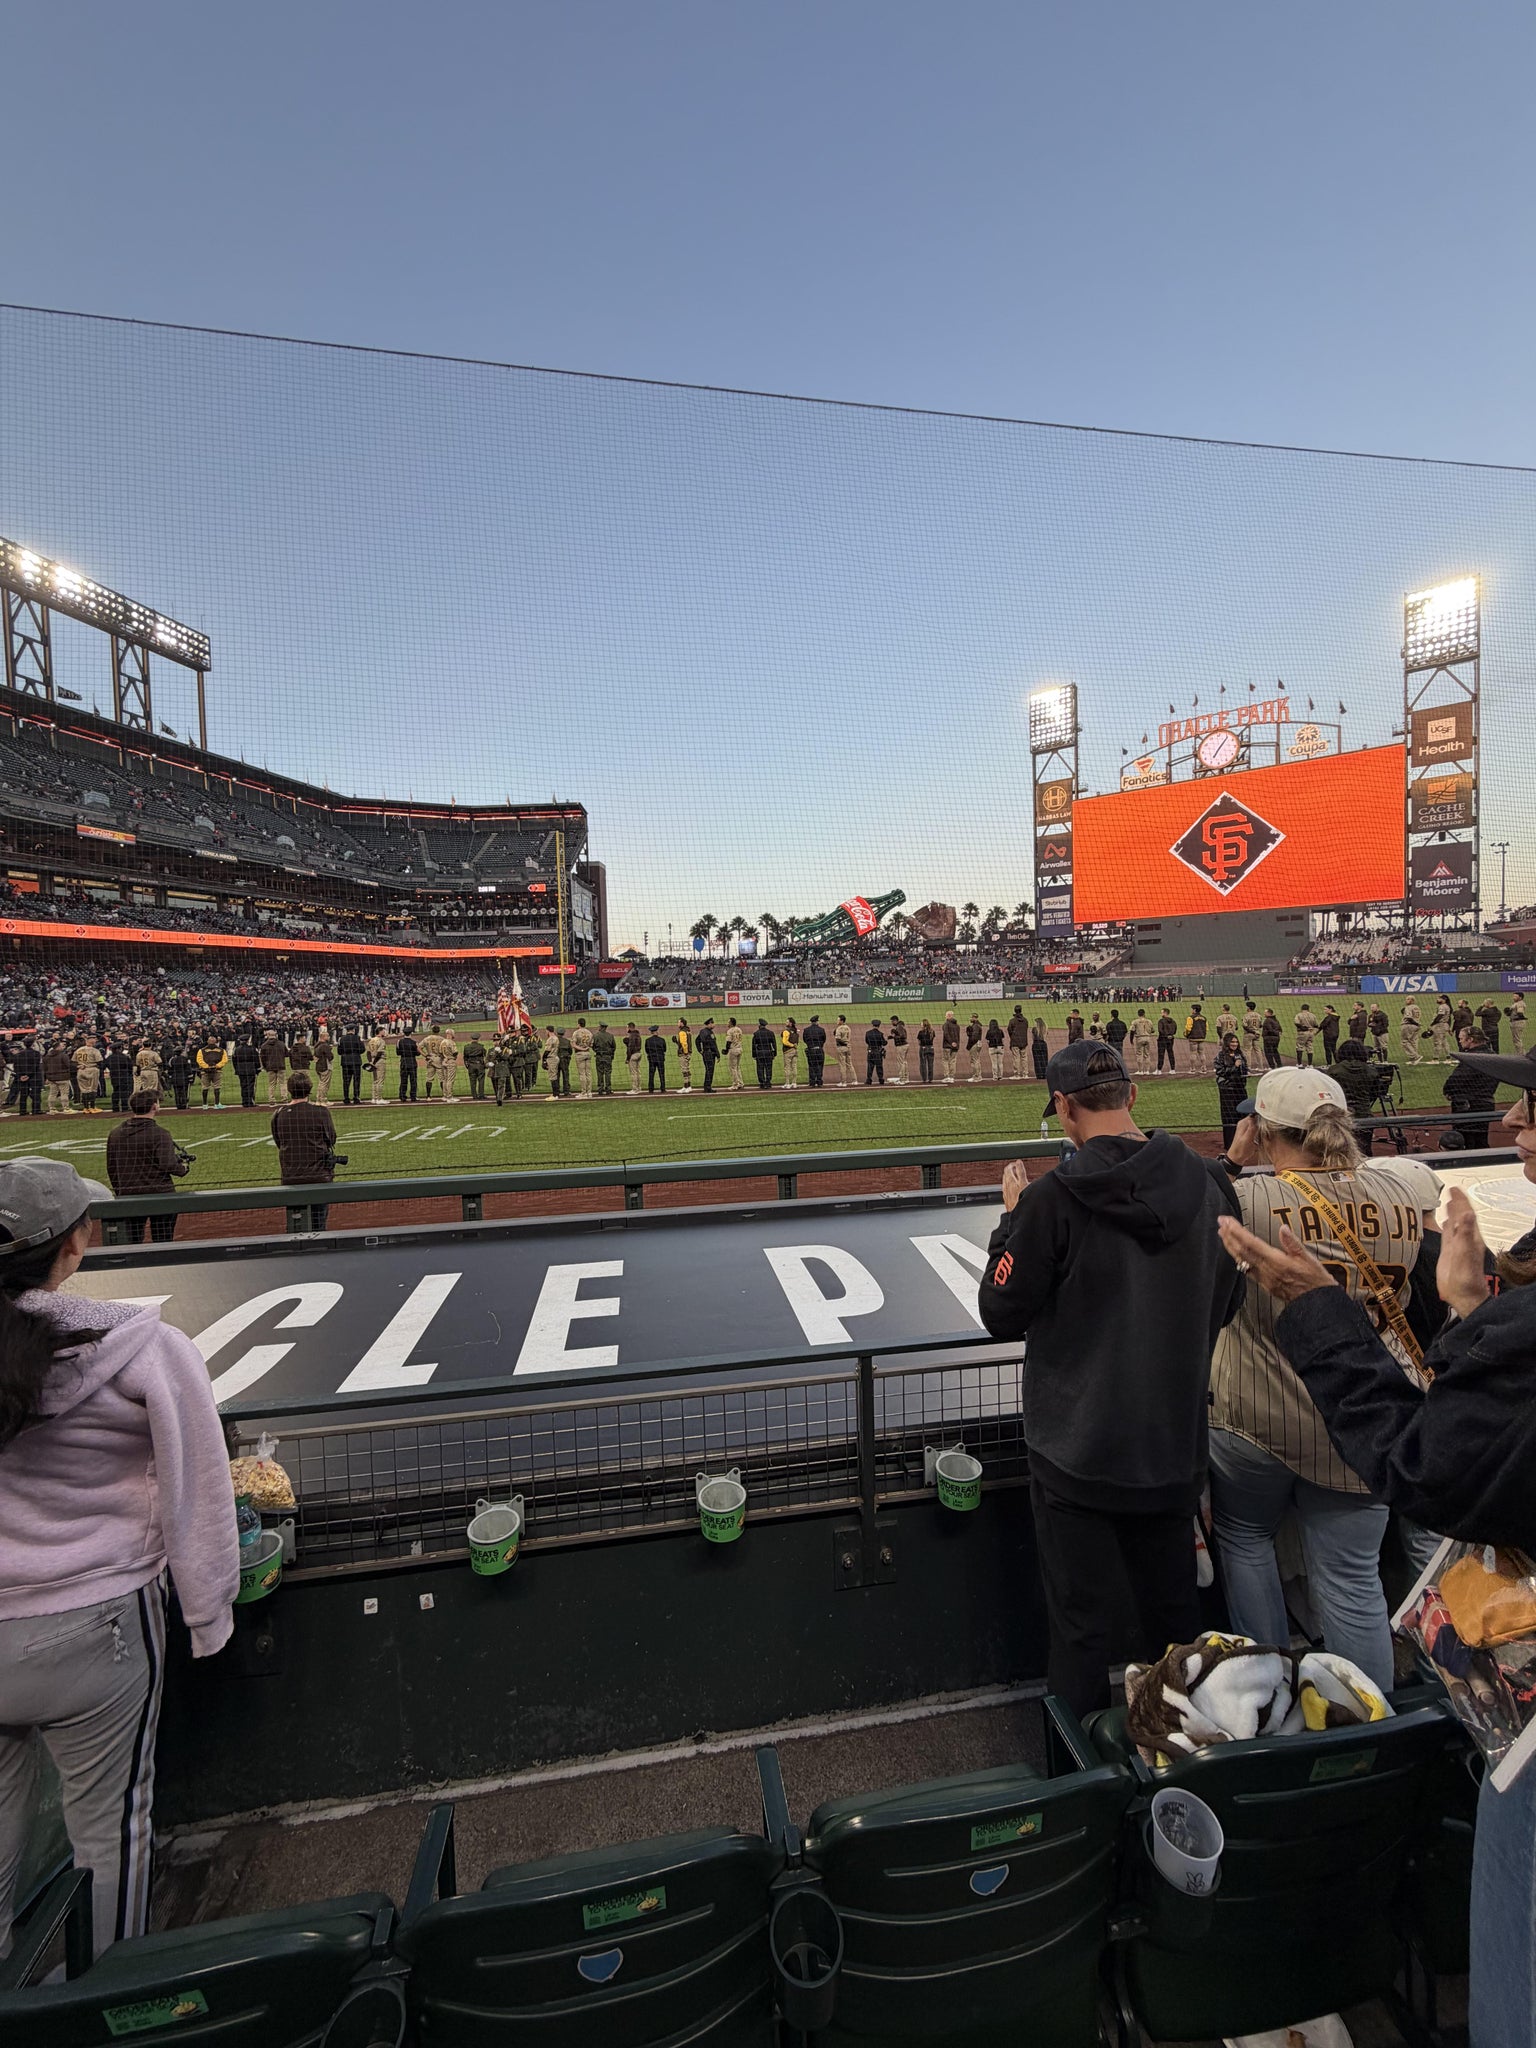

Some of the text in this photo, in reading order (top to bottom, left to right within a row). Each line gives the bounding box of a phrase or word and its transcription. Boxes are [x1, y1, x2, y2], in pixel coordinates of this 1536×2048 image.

[1158, 696, 1291, 748] ORACLE PARK
[1430, 725, 1452, 734] UCSF
[1289, 740, 1327, 757] coupa
[1418, 741, 1465, 757] Health
[1122, 771, 1168, 788] Fanatics
[1418, 802, 1466, 816] CACHE
[1419, 811, 1464, 824] CREEK
[1039, 860, 1072, 870] Airwallex
[1415, 876, 1468, 890] Benjamin
[1422, 887, 1462, 897] Moore
[1379, 975, 1439, 993] VISA
[884, 987, 925, 998] National
[77, 1053, 88, 1062] 20
[715, 1516, 735, 1525] EATS
[478, 1549, 499, 1558] EATS
